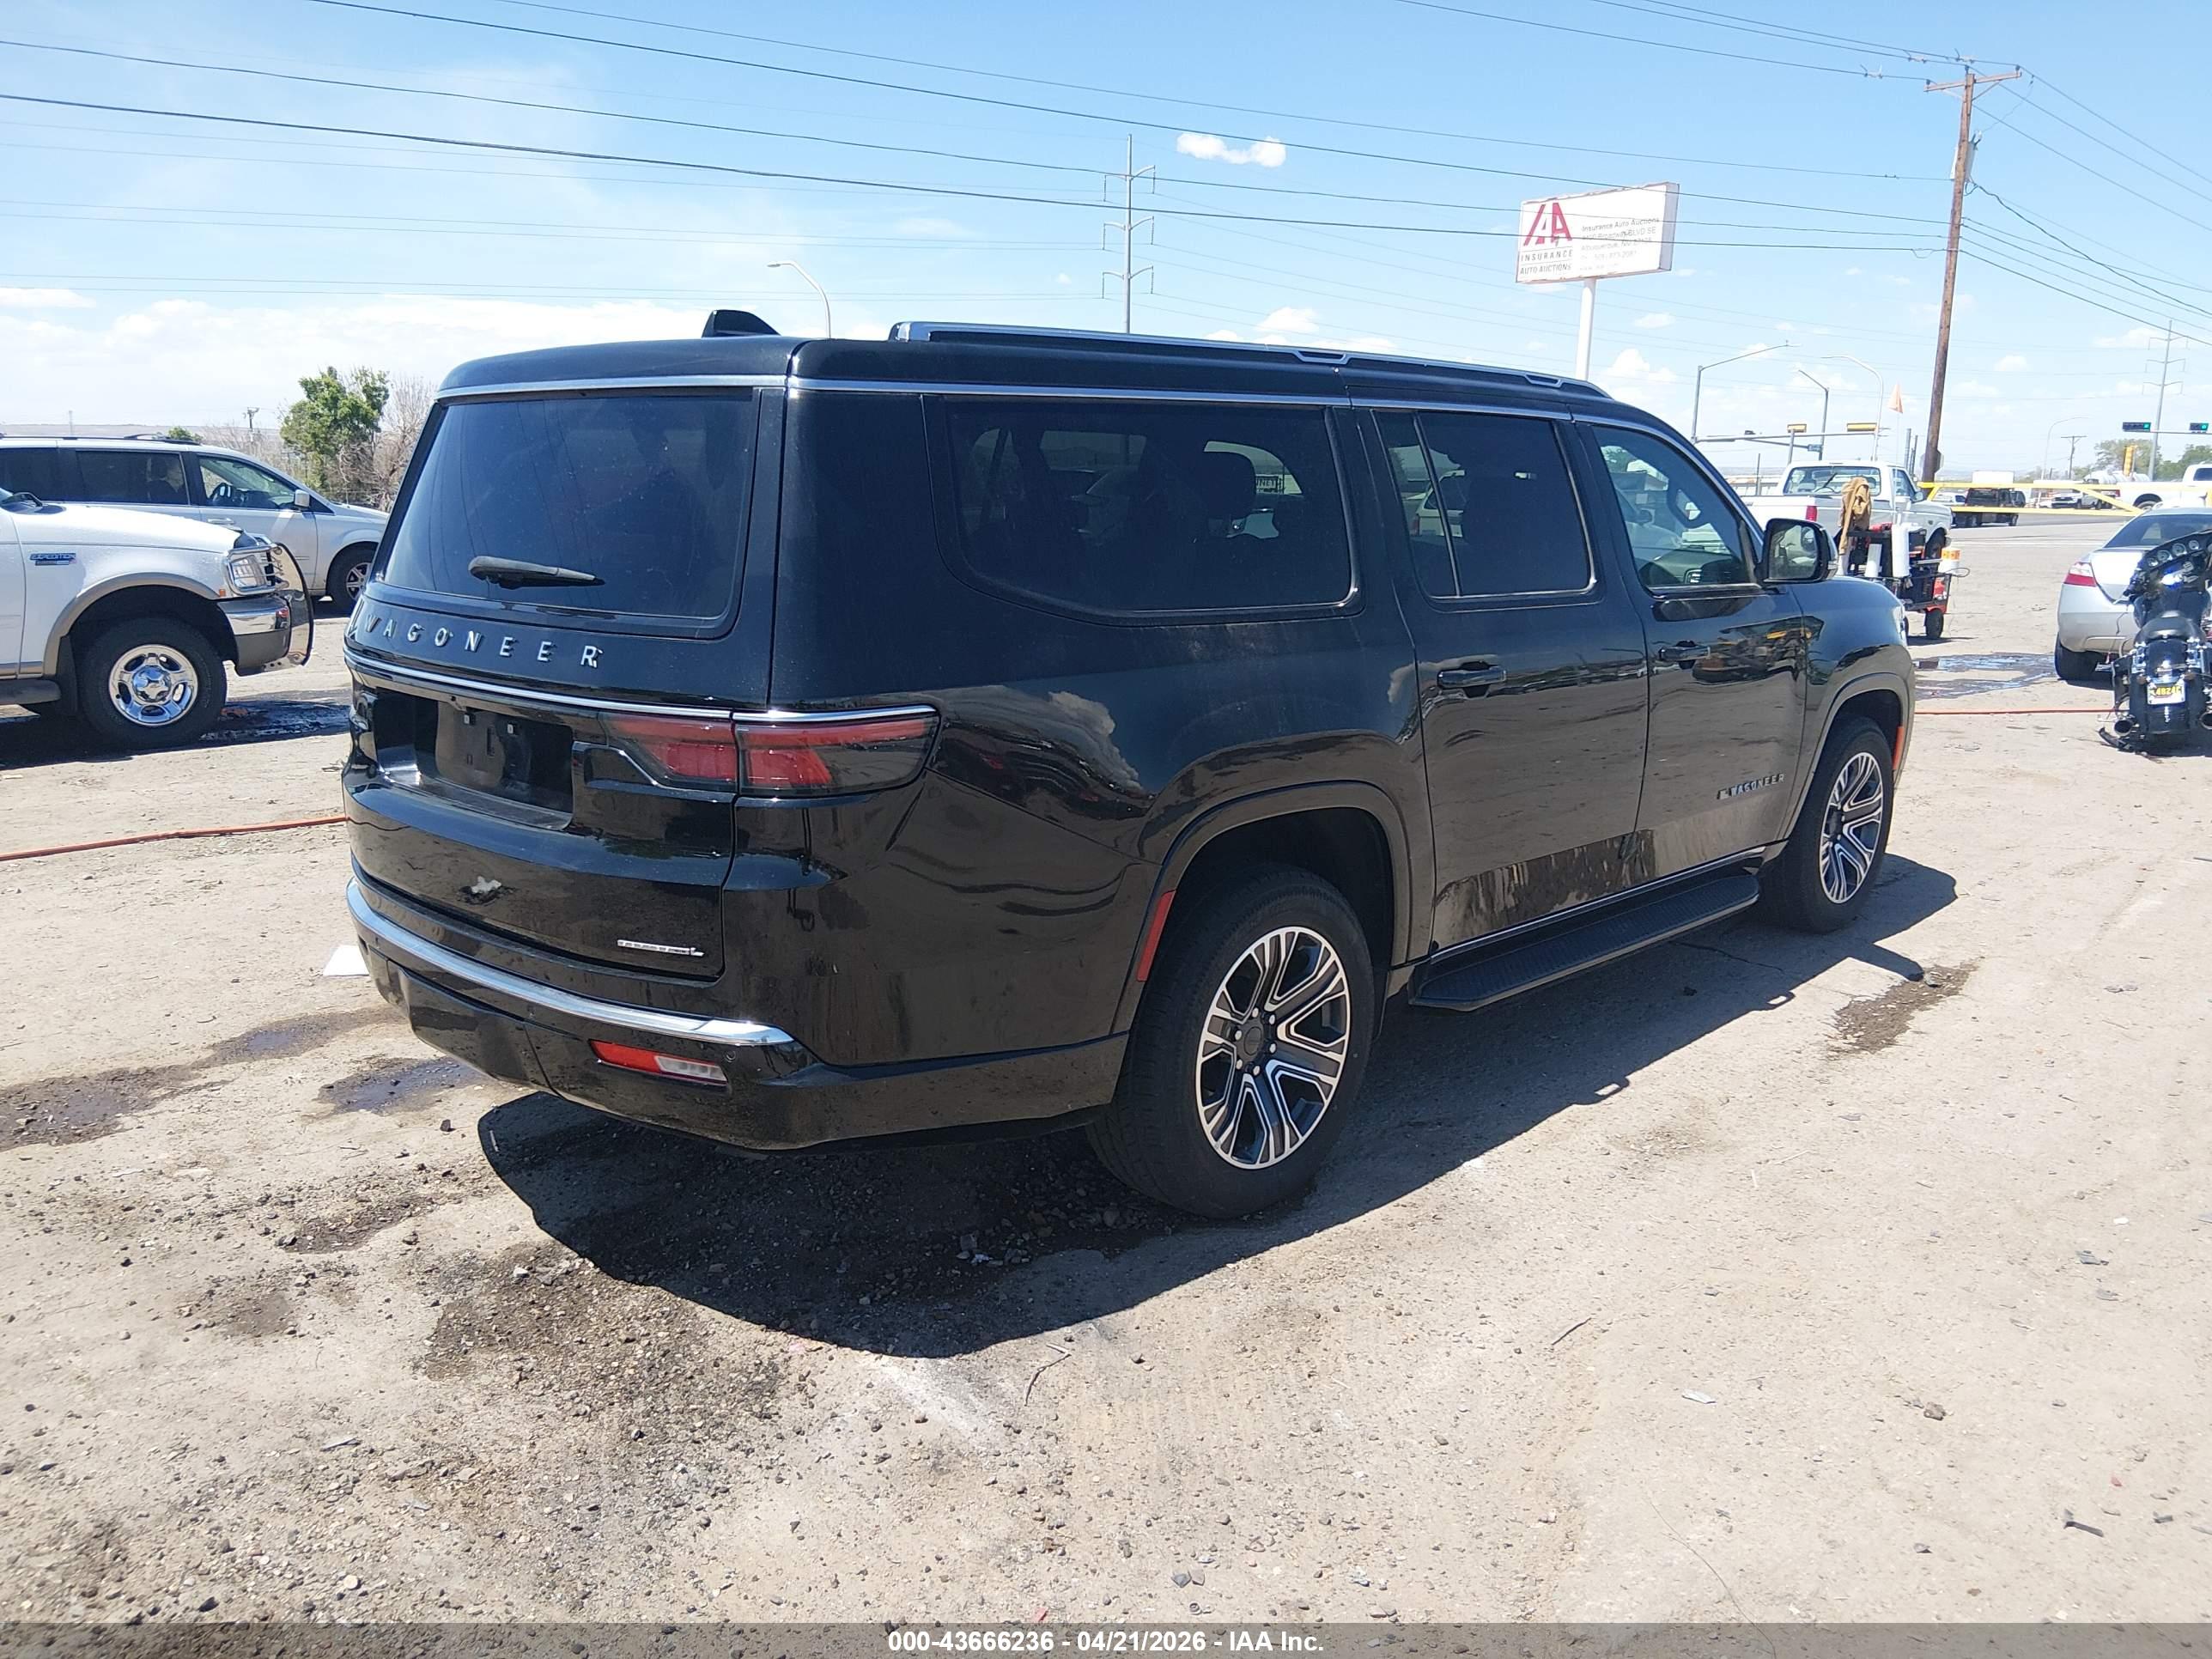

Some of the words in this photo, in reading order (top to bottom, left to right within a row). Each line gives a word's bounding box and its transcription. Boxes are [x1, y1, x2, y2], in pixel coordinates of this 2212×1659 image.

[1582, 223, 1613, 233] Insurance
[1521, 249, 1573, 263] INSURANCE
[1520, 265, 1538, 275] AUTO
[1539, 263, 1571, 273] AUCTIONS
[365, 614, 605, 668] WAGONEER
[1731, 773, 1785, 797] WAGONEER
